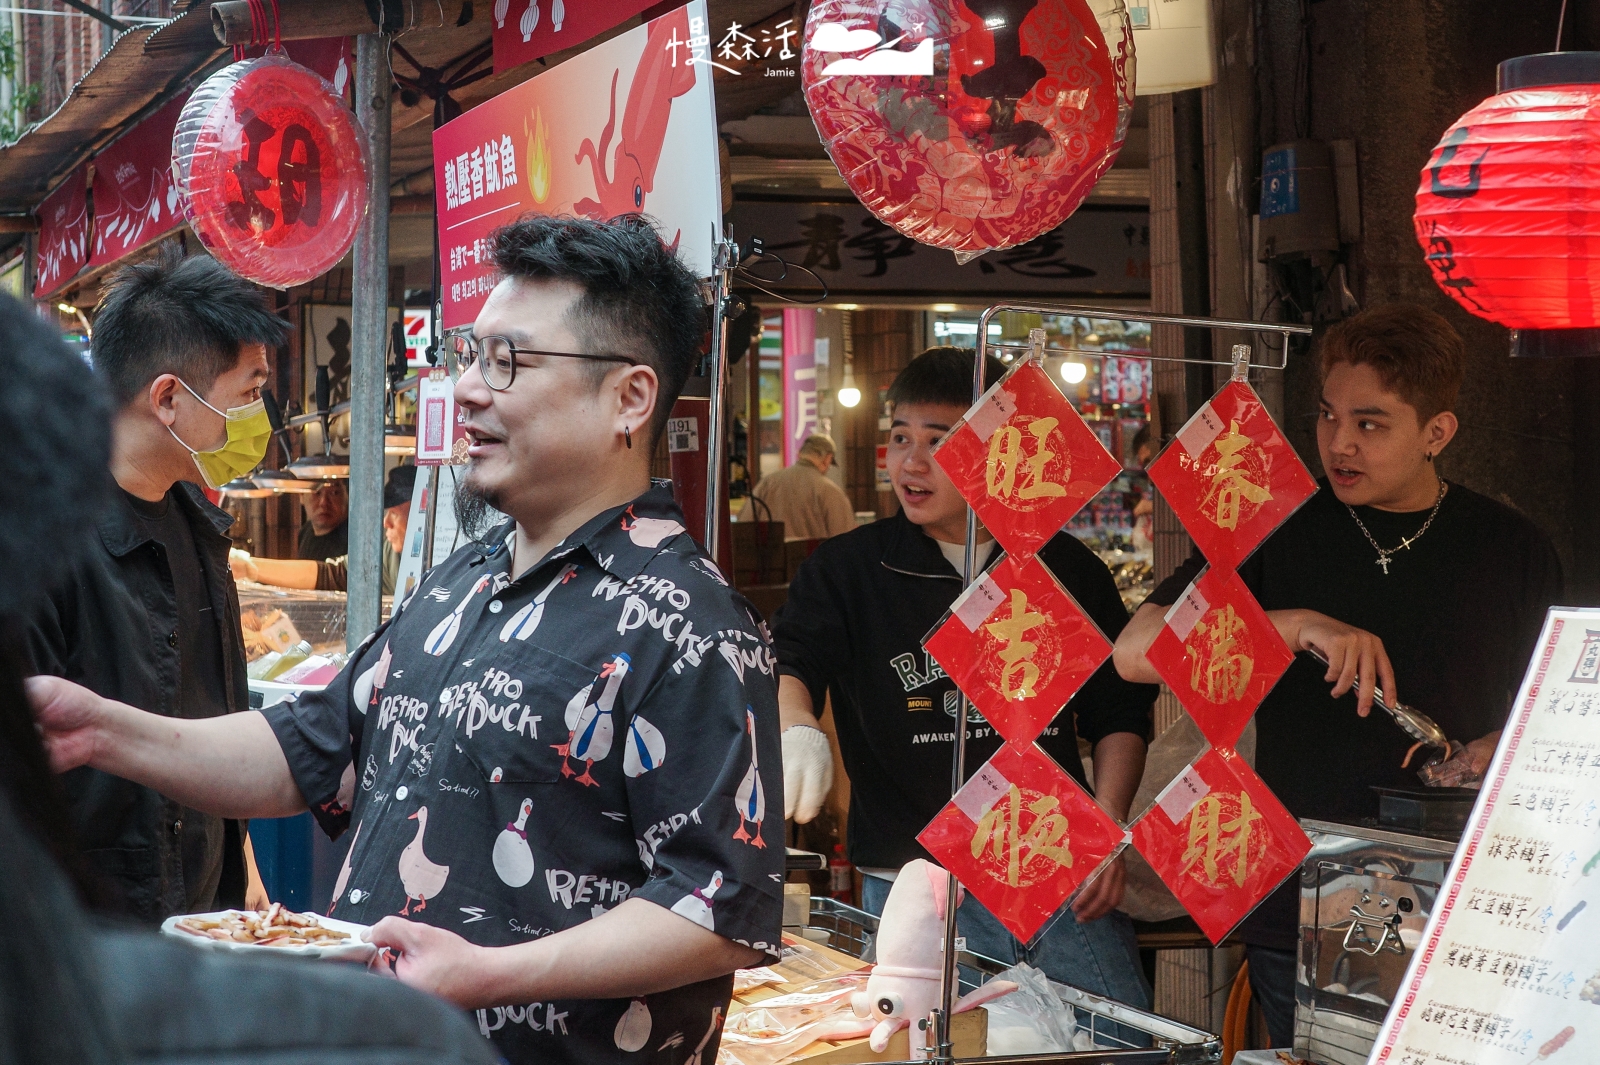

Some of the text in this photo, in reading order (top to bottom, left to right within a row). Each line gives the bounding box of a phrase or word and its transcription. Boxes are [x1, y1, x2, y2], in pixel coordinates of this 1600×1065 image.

[444, 133, 518, 211] 熱壓香魷魚
[451, 282, 461, 303] 대만
[985, 416, 1067, 501] 旺
[1197, 419, 1275, 532] 春
[985, 588, 1048, 703] 吉
[1186, 603, 1254, 703] 滿
[907, 700, 932, 709] MOUNT
[912, 729, 971, 744] AWAKEND
[975, 727, 991, 739] BY
[971, 783, 1074, 889] 順
[1181, 790, 1263, 889] 財
